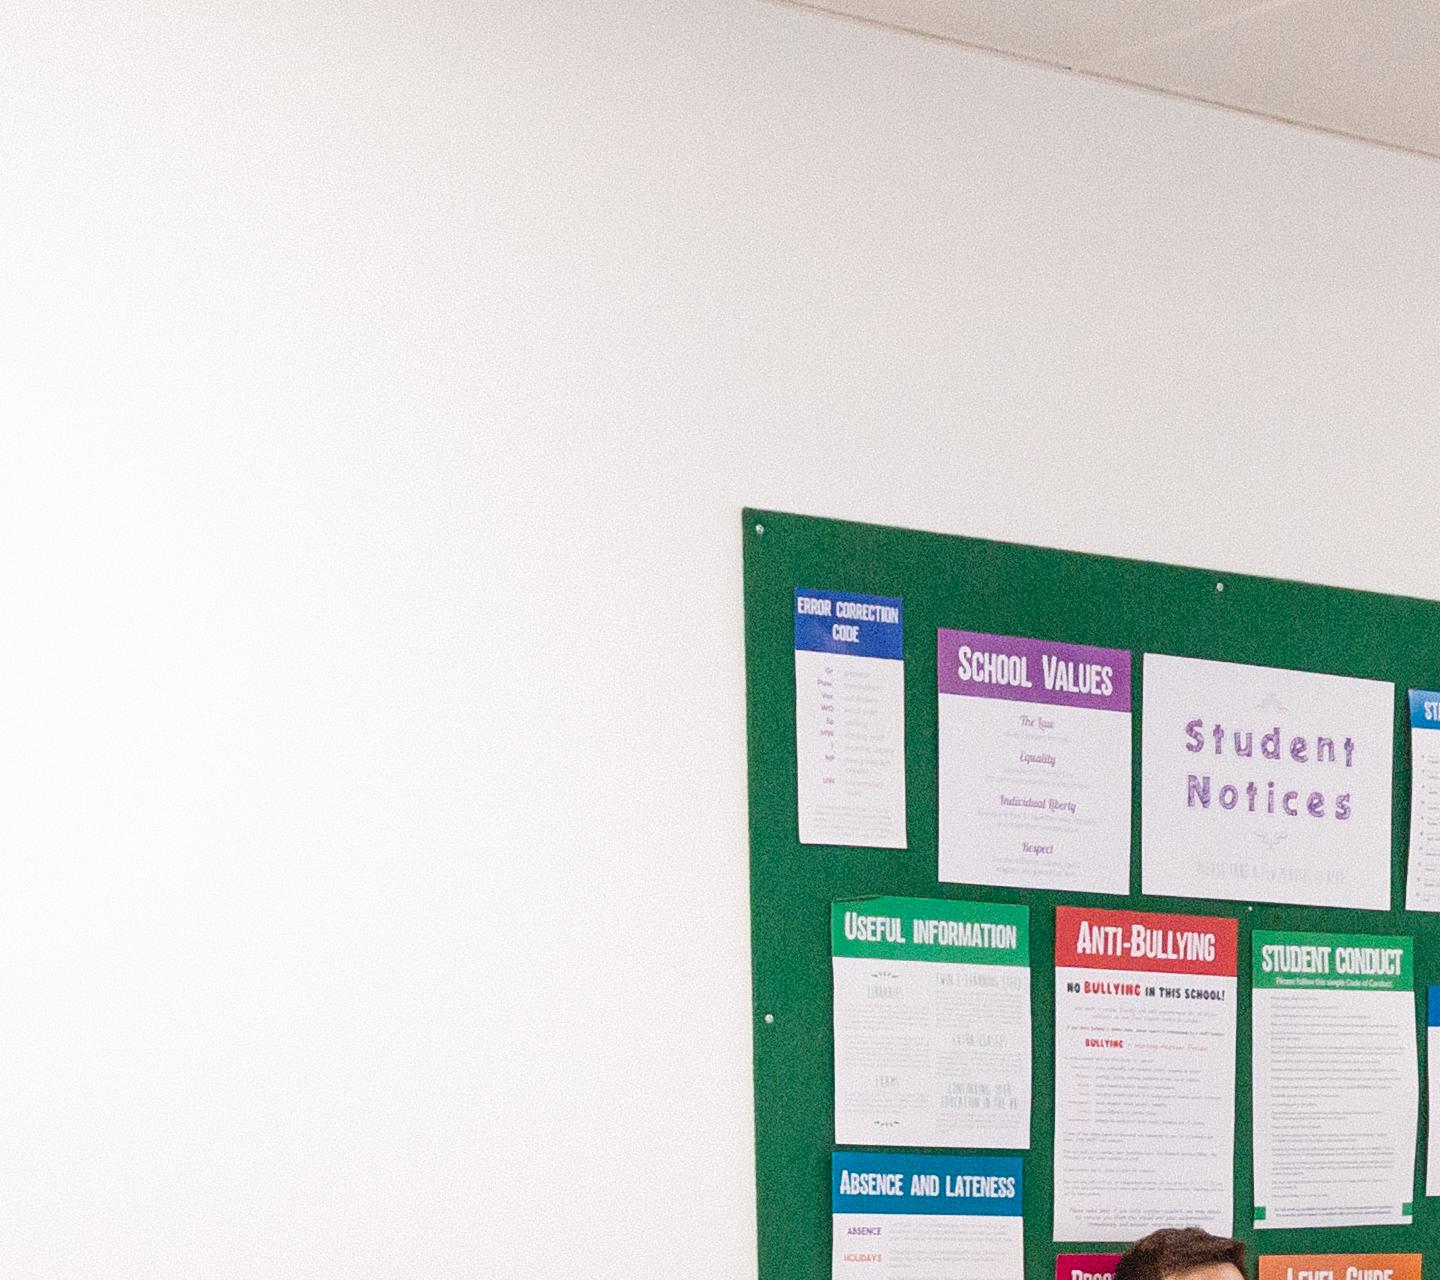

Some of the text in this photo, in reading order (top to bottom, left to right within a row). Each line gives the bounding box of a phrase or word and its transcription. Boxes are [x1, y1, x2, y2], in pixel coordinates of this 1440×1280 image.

[798, 597, 899, 623] ERROR CORRECTION
[833, 624, 860, 642] CODE
[958, 646, 1113, 697] SCHOOL VALUES
[1185, 718, 1355, 767] Student
[1019, 751, 1056, 768] Equality
[1187, 774, 1351, 820] Notices
[1022, 842, 1053, 856] Respect
[844, 910, 1017, 950] USEFUL INFORMATION
[1077, 920, 1216, 962] ANTI-BULLYING
[1262, 944, 1404, 976] STUDENT CONDUCT
[1067, 980, 1226, 1001] NO BULLYING IN THIS SCHOOL!
[1085, 1038, 1124, 1049] BULLYING
[840, 1168, 1016, 1199] ABSENCE AND LATENESS
[847, 1227, 881, 1236] ABSENCE
[844, 1254, 882, 1263] HOLIDAYS
